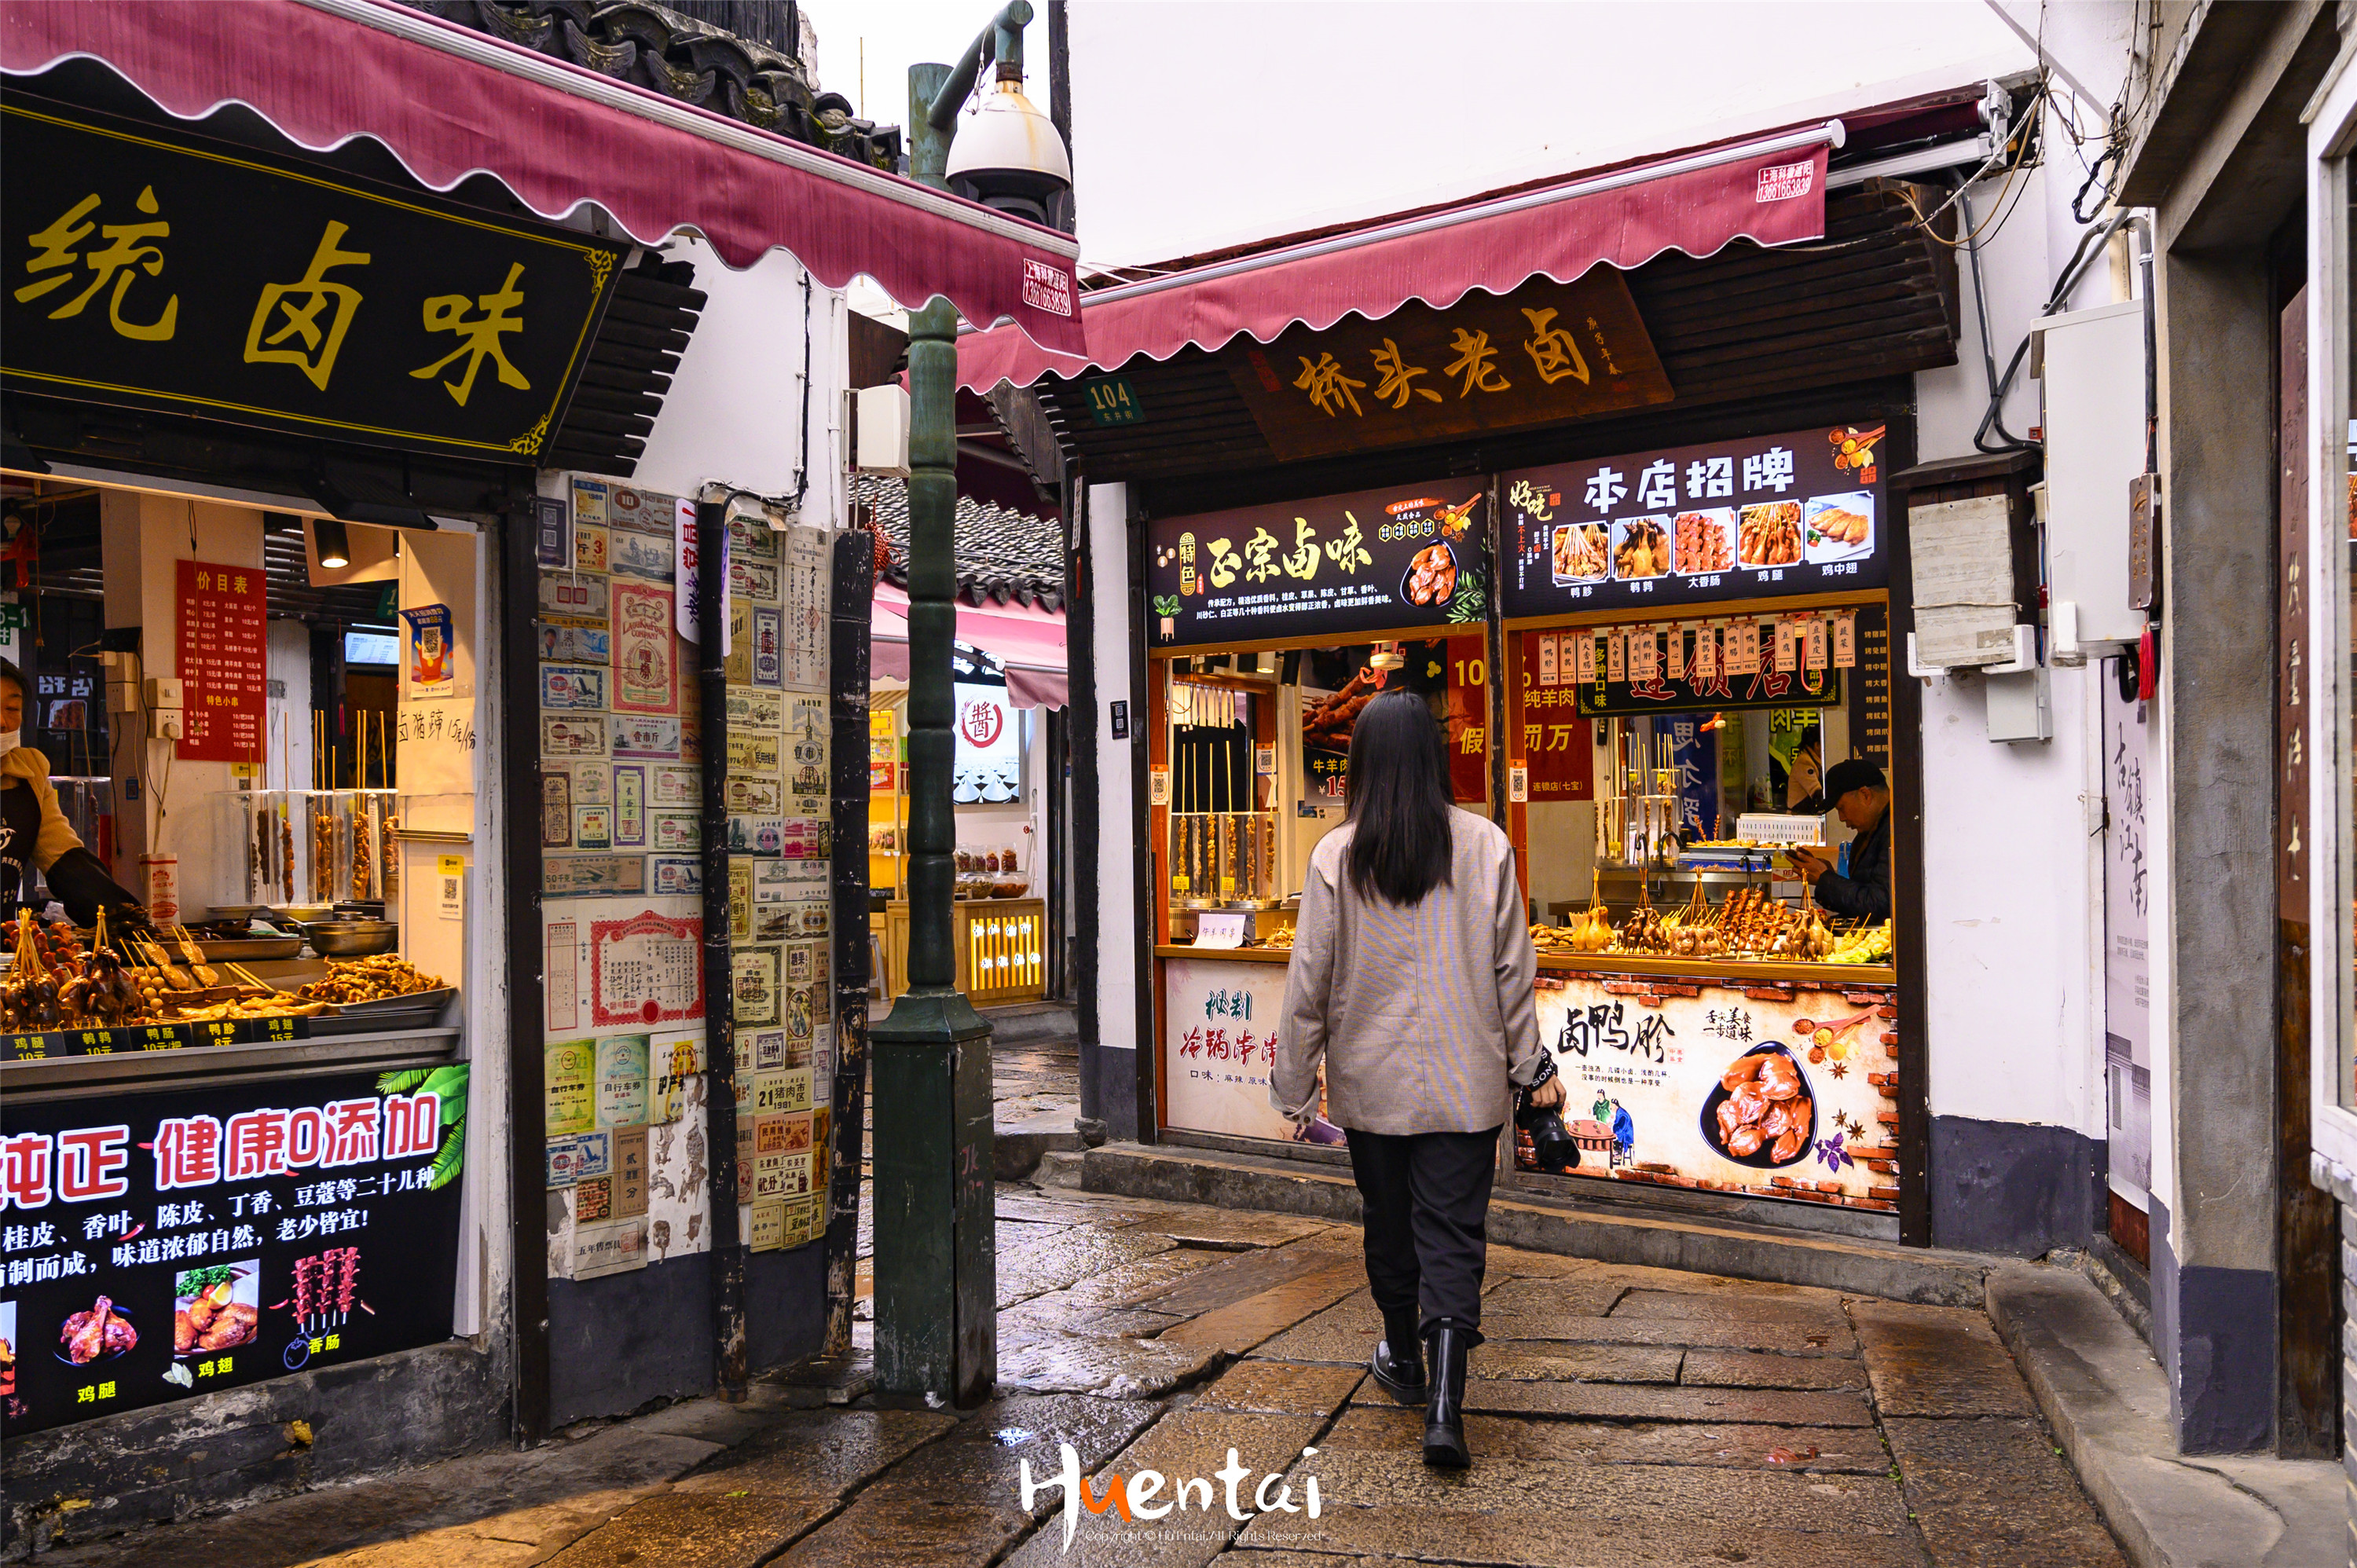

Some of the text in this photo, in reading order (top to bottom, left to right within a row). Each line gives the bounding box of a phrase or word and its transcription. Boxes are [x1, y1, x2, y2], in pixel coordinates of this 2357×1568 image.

[14, 185, 530, 406] 统卤味
[1293, 307, 1589, 417] 桥头老卤
[1091, 383, 1130, 409] 104
[1585, 446, 1794, 515] 本店招牌
[1509, 480, 1552, 521] 好吃
[1206, 511, 1372, 588] 正宗卤味
[1181, 544, 1194, 584] 特色
[1821, 561, 1857, 577] 鸡中翅
[197, 570, 248, 595] 价目表
[1688, 574, 1721, 589] 大香肠
[1757, 568, 1783, 582] 鸡腿
[1629, 580, 1653, 593] 鹌鹑
[631, 631, 659, 640] COMPANY
[1781, 632, 1790, 653] 豆腐
[1812, 625, 1821, 654] 豆腐皮
[1583, 642, 1592, 669] 大香肠
[1594, 648, 1607, 707] 多种口味
[206, 694, 239, 707] 特色小串
[1524, 687, 1574, 708] 纯羊肉
[398, 709, 444, 742] 卤猪蹄
[1533, 782, 1582, 792] 连锁店(七宝)
[1204, 987, 1253, 1021] 秘制
[146, 1027, 174, 1040] 鸭肠
[208, 1023, 236, 1036] 鸭胗
[269, 1018, 294, 1031] 鸡翅
[15, 1037, 45, 1050] 鸡腿
[82, 1031, 112, 1045] 鹌鹑
[551, 1083, 586, 1094] 自行车券
[604, 1082, 642, 1093] 自行车券
[759, 1090, 773, 1108] 21
[775, 1085, 795, 1099] 猪肉
[796, 1083, 806, 1102] 市区
[774, 1101, 791, 1110] 1981
[155, 1091, 442, 1191] 健康0添加
[575, 1237, 622, 1257] 五年售票员
[307, 1333, 339, 1355] 香肠
[198, 1356, 233, 1378] 鸡翅
[77, 1380, 116, 1404] 鸡腿
